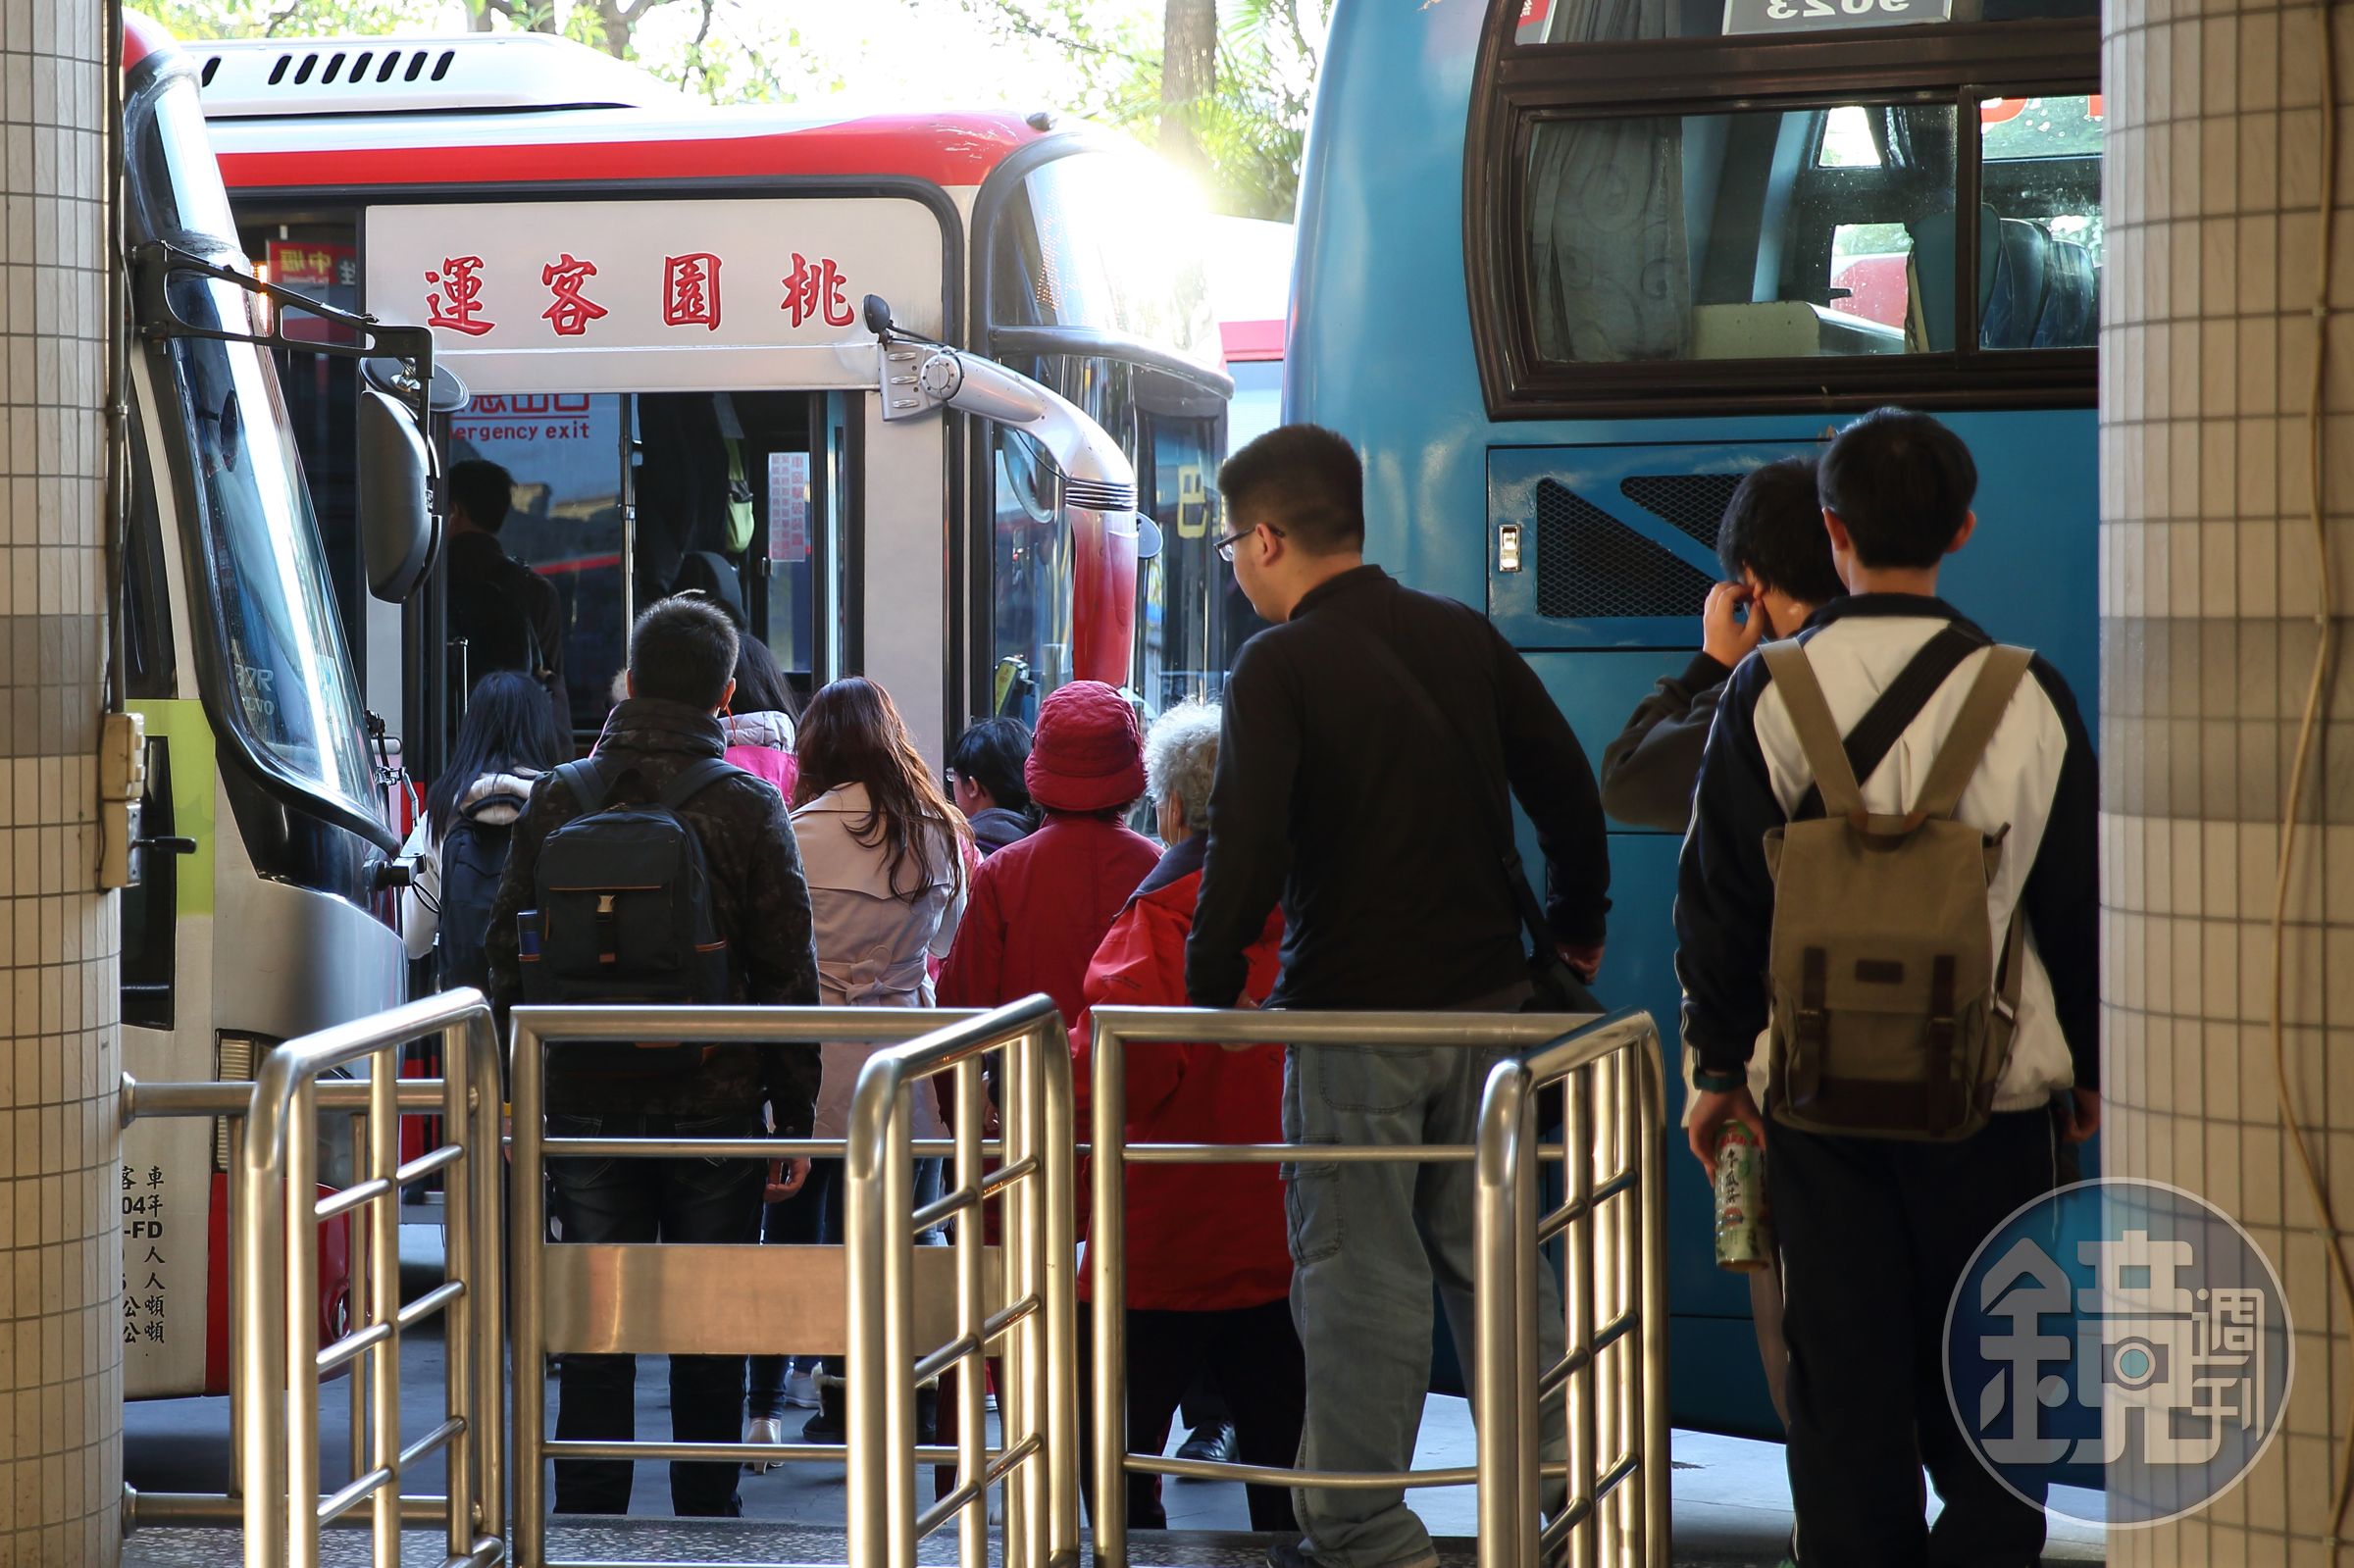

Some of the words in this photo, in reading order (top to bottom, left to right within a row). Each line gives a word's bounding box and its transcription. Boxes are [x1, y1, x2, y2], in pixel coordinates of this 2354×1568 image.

[545, 421, 589, 438] exit
[144, 1245, 166, 1263] 人
[144, 1272, 166, 1290] 人
